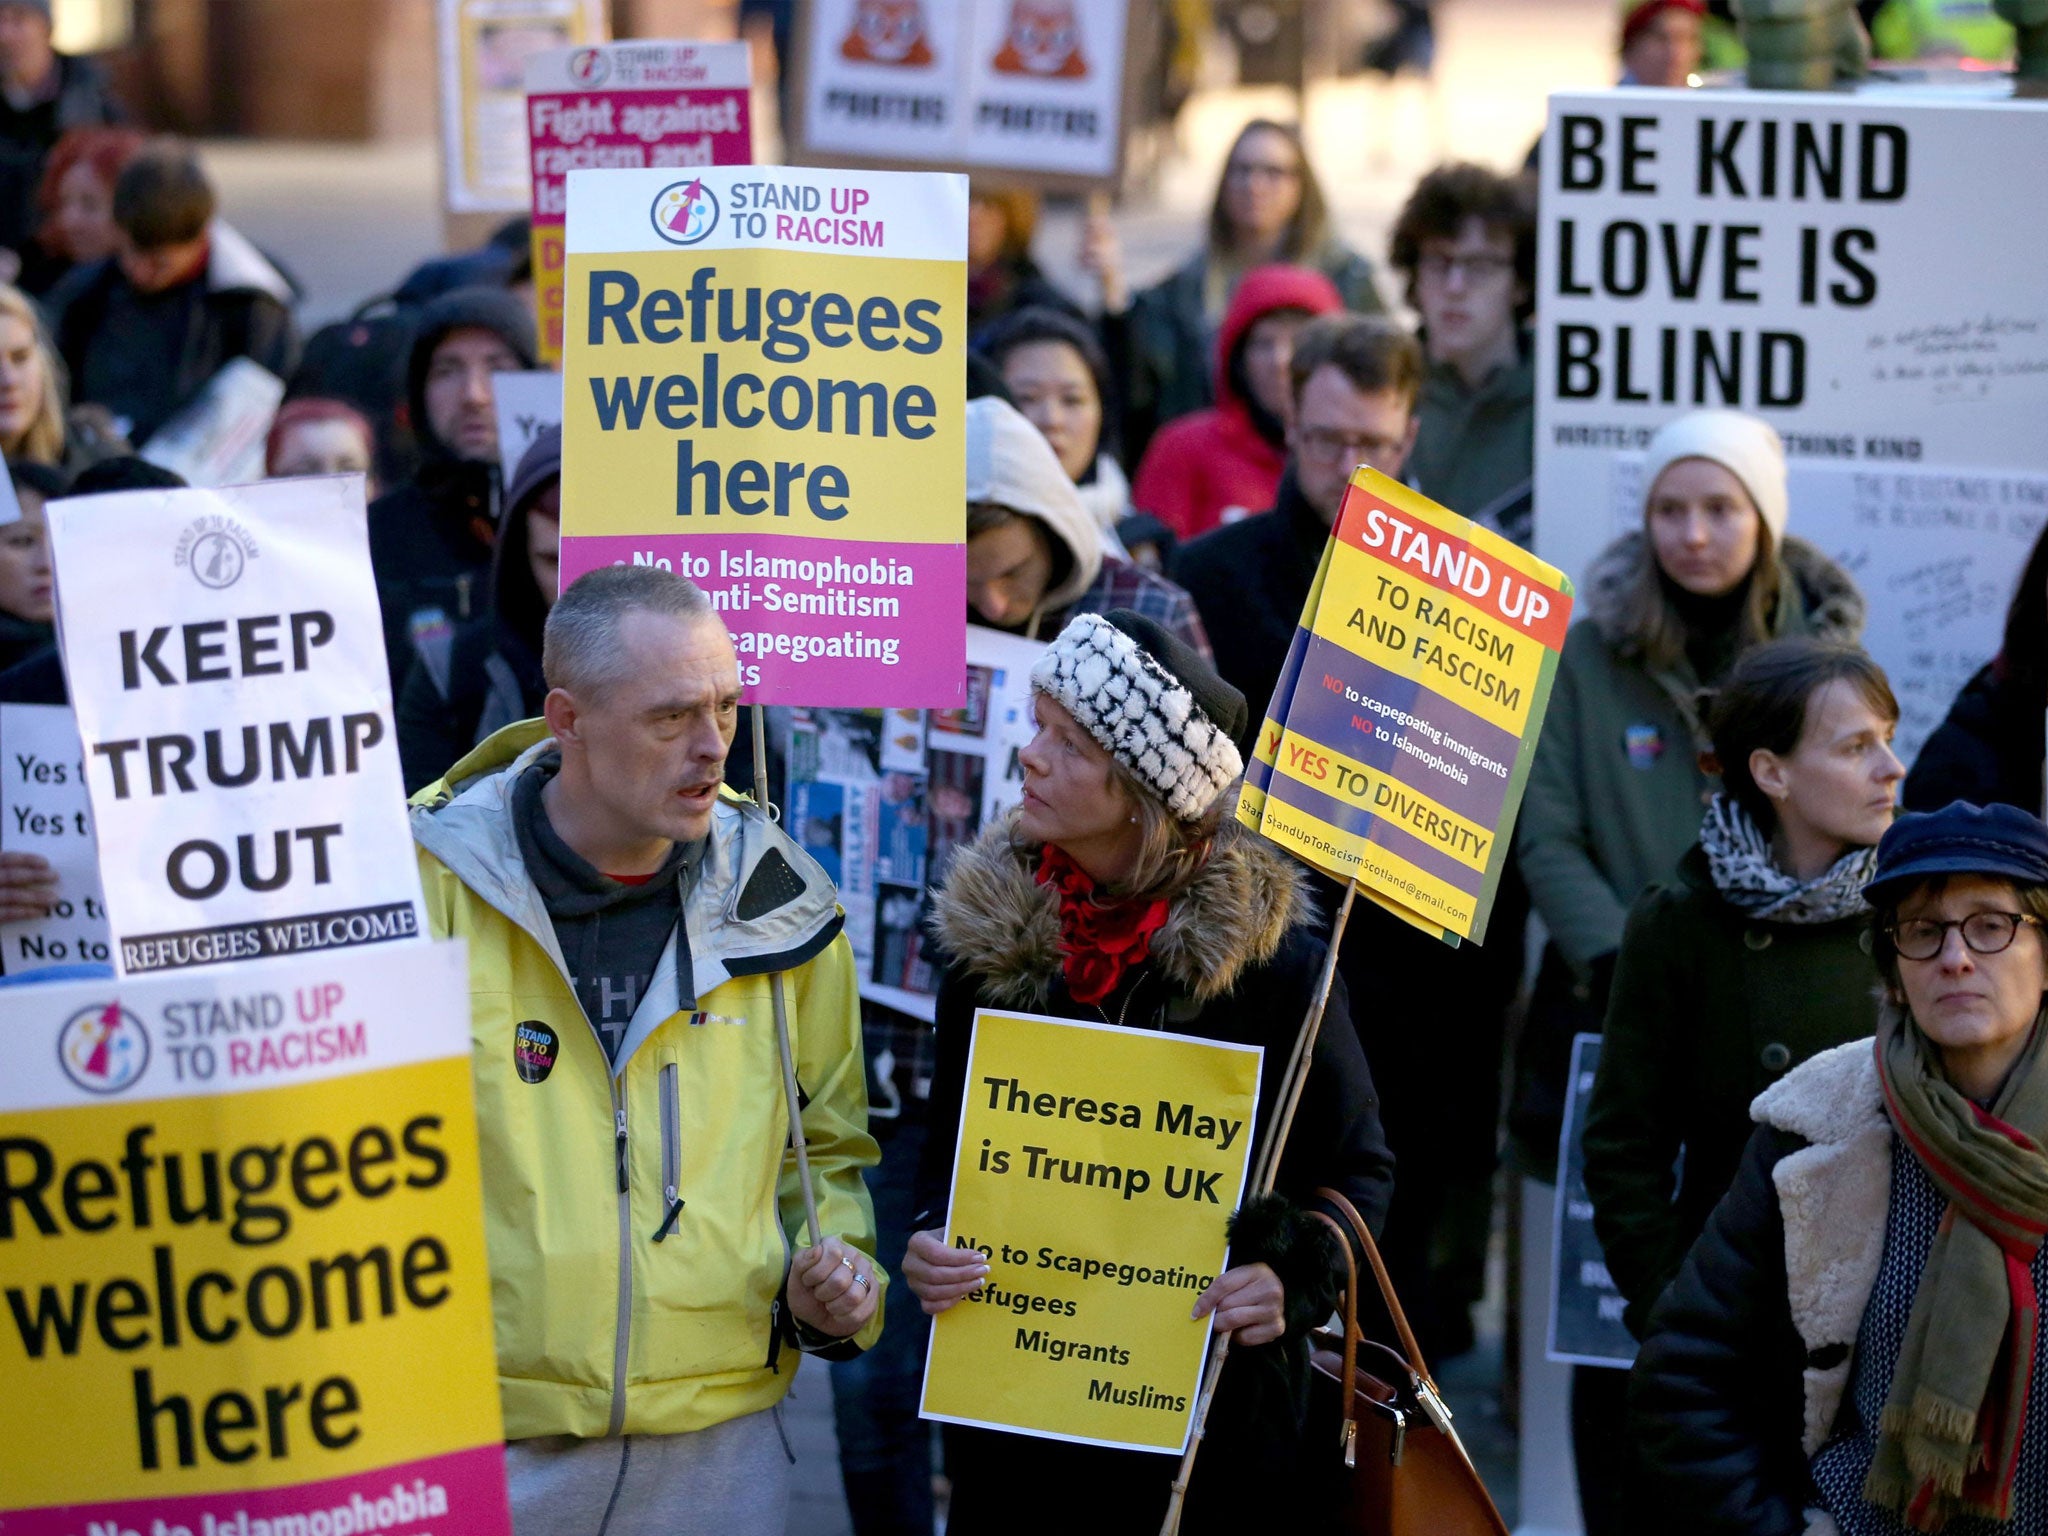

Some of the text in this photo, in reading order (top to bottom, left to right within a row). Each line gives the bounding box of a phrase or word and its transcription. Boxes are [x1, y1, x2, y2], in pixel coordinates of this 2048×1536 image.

[531, 96, 615, 144] Fight
[620, 95, 741, 143] against
[534, 137, 645, 176] racism
[650, 135, 714, 168] and
[1559, 113, 1911, 204] BE KIND
[730, 183, 869, 215] STAND UP
[730, 213, 884, 248] TO RACISM
[1556, 217, 1880, 310] LOVE IS
[587, 267, 943, 364] Refugees
[589, 353, 937, 440] welcome
[1555, 322, 1807, 411] BLIND
[676, 440, 850, 521] here
[1863, 436, 1923, 462] KIND
[681, 551, 710, 578] to
[720, 550, 914, 588] Islamophobia
[1361, 509, 1550, 628] STAND UP
[118, 610, 335, 691] KEEP
[729, 631, 900, 664] capegoating
[1376, 575, 1514, 667] TO RACISM
[1347, 607, 1520, 712] AND FASCISM
[93, 711, 385, 800] TRUMP
[1322, 673, 1508, 779] NO to scapegoating immigrants
[1351, 714, 1469, 786] NO to Islamophobia
[16, 753, 67, 784] Yes
[1289, 742, 1330, 780] YES
[1335, 764, 1369, 797] TO
[1373, 782, 1488, 860] DIVERSITY
[13, 806, 64, 836] Yes
[166, 823, 343, 900] OUT
[1266, 814, 1468, 922] StandUpToRacismScotland@gmail.com
[20, 933, 109, 961] No to
[123, 907, 418, 972] REFUGEES WELCOME
[163, 983, 344, 1040] STAND UP
[517, 1027, 552, 1045] STAND
[167, 1021, 369, 1083] TO RACISM
[516, 1045, 553, 1068] RACISM
[517, 1037, 548, 1056] UP TO
[983, 1076, 1243, 1152] Theresa May
[0, 1113, 450, 1248] Refugees
[978, 1138, 1224, 1205] is Trump UK
[5, 1234, 453, 1359] welcome
[956, 1236, 1214, 1296] No to Scapegoating
[961, 1282, 1078, 1317] efugees
[1014, 1328, 1131, 1367] Migrants
[133, 1367, 362, 1472] here
[1087, 1379, 1187, 1412] Muslims
